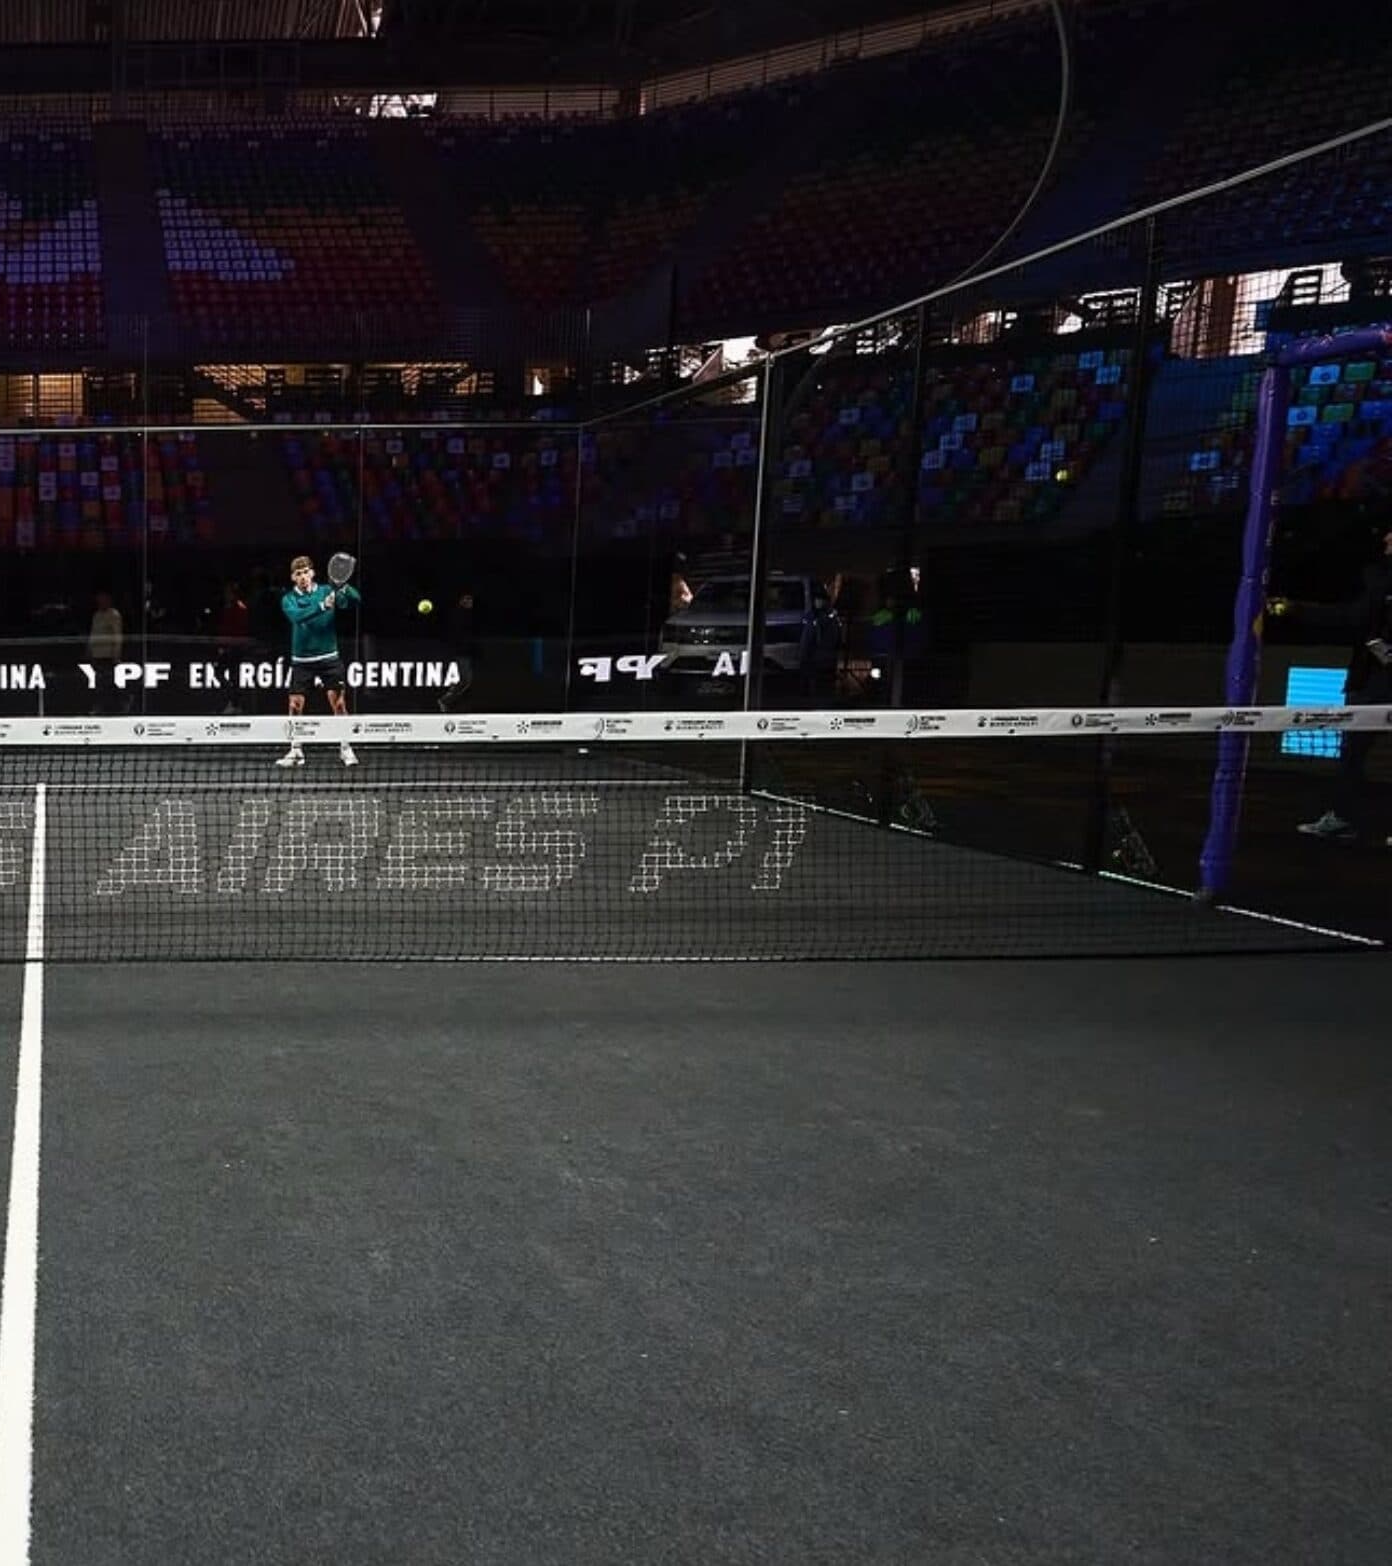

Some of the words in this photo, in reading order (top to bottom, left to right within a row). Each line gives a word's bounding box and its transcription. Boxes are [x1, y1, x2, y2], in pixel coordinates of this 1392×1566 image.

[189, 657, 294, 689] ENRGÍ
[314, 661, 460, 688] GENTINA
[92, 791, 601, 896] AIRES
